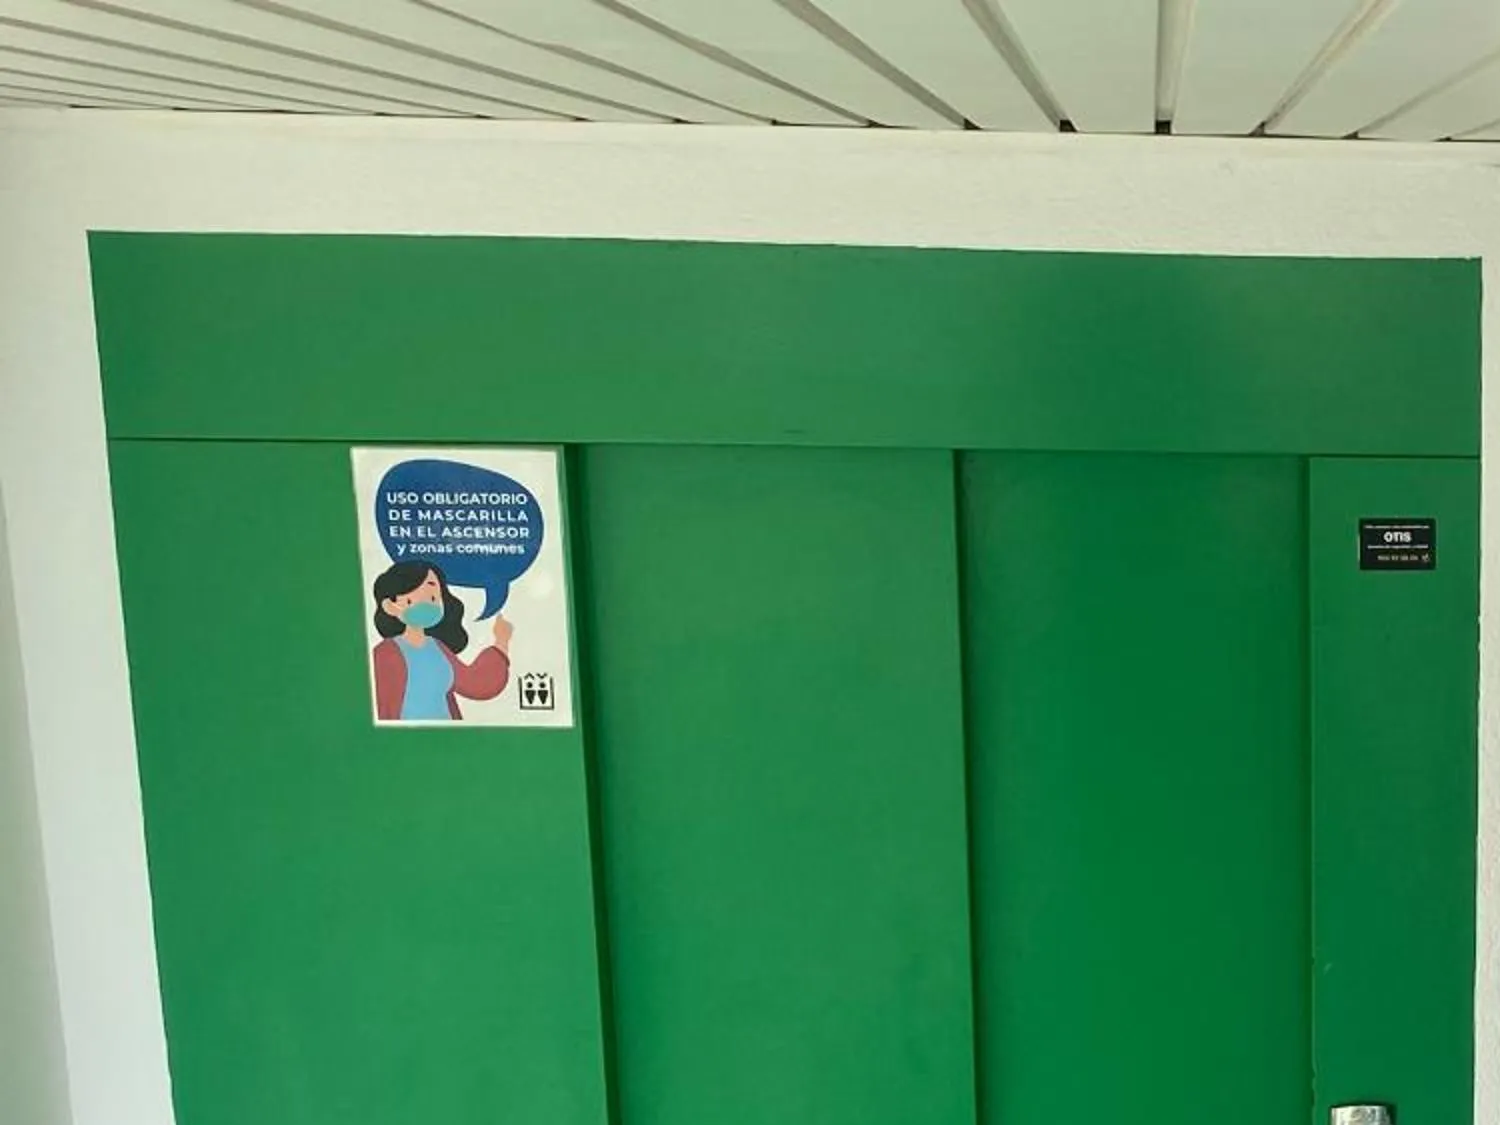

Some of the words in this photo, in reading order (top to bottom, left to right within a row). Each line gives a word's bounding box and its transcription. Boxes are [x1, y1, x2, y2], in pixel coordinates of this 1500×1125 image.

[387, 491, 418, 505] USO
[423, 491, 527, 505] OBLIGATORIO
[388, 509, 411, 522] DE
[418, 509, 529, 522] MASCARILLA
[390, 526, 411, 538] EN
[417, 526, 436, 538] EL
[441, 526, 529, 538] ASCENSOR
[397, 543, 405, 556] y
[410, 543, 452, 554] zonas
[456, 543, 525, 555] comunes
